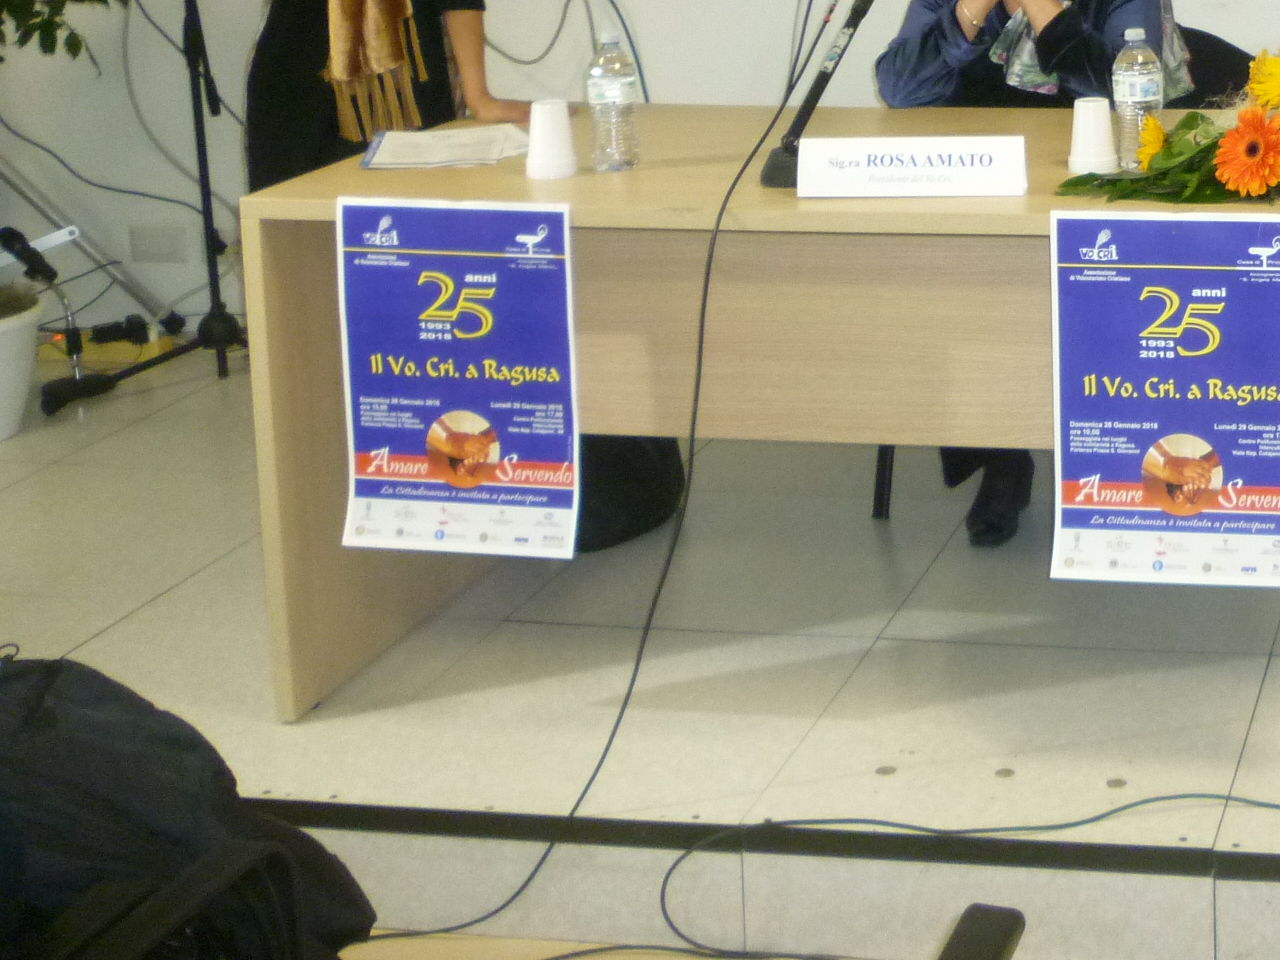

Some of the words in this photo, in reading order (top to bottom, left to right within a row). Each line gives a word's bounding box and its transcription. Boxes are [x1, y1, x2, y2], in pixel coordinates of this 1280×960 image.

[866, 153, 918, 168] ROSA
[921, 153, 994, 168] AMATO
[464, 272, 497, 283] anni
[1192, 288, 1226, 297] anni
[417, 270, 496, 339] 25
[419, 321, 451, 330] 1993
[1139, 287, 1225, 356] 25
[419, 332, 452, 340] 2018
[370, 353, 382, 374] Il
[387, 355, 421, 377] Vo.
[426, 357, 460, 379] Cri.
[465, 363, 478, 379] a
[482, 358, 560, 386] Ragusa
[1083, 374, 1096, 396] Il
[1101, 377, 1138, 398] Vo.
[1145, 377, 1180, 399] Cri.
[1187, 385, 1201, 399] a
[366, 446, 428, 474] Amare
[495, 453, 573, 484] Servendo
[1075, 473, 1143, 503] Amare
[1090, 515, 1104, 524] La
[1106, 515, 1167, 526] Cittadinanza
[1176, 518, 1211, 528] invitata
[1221, 520, 1276, 532] partecipare
